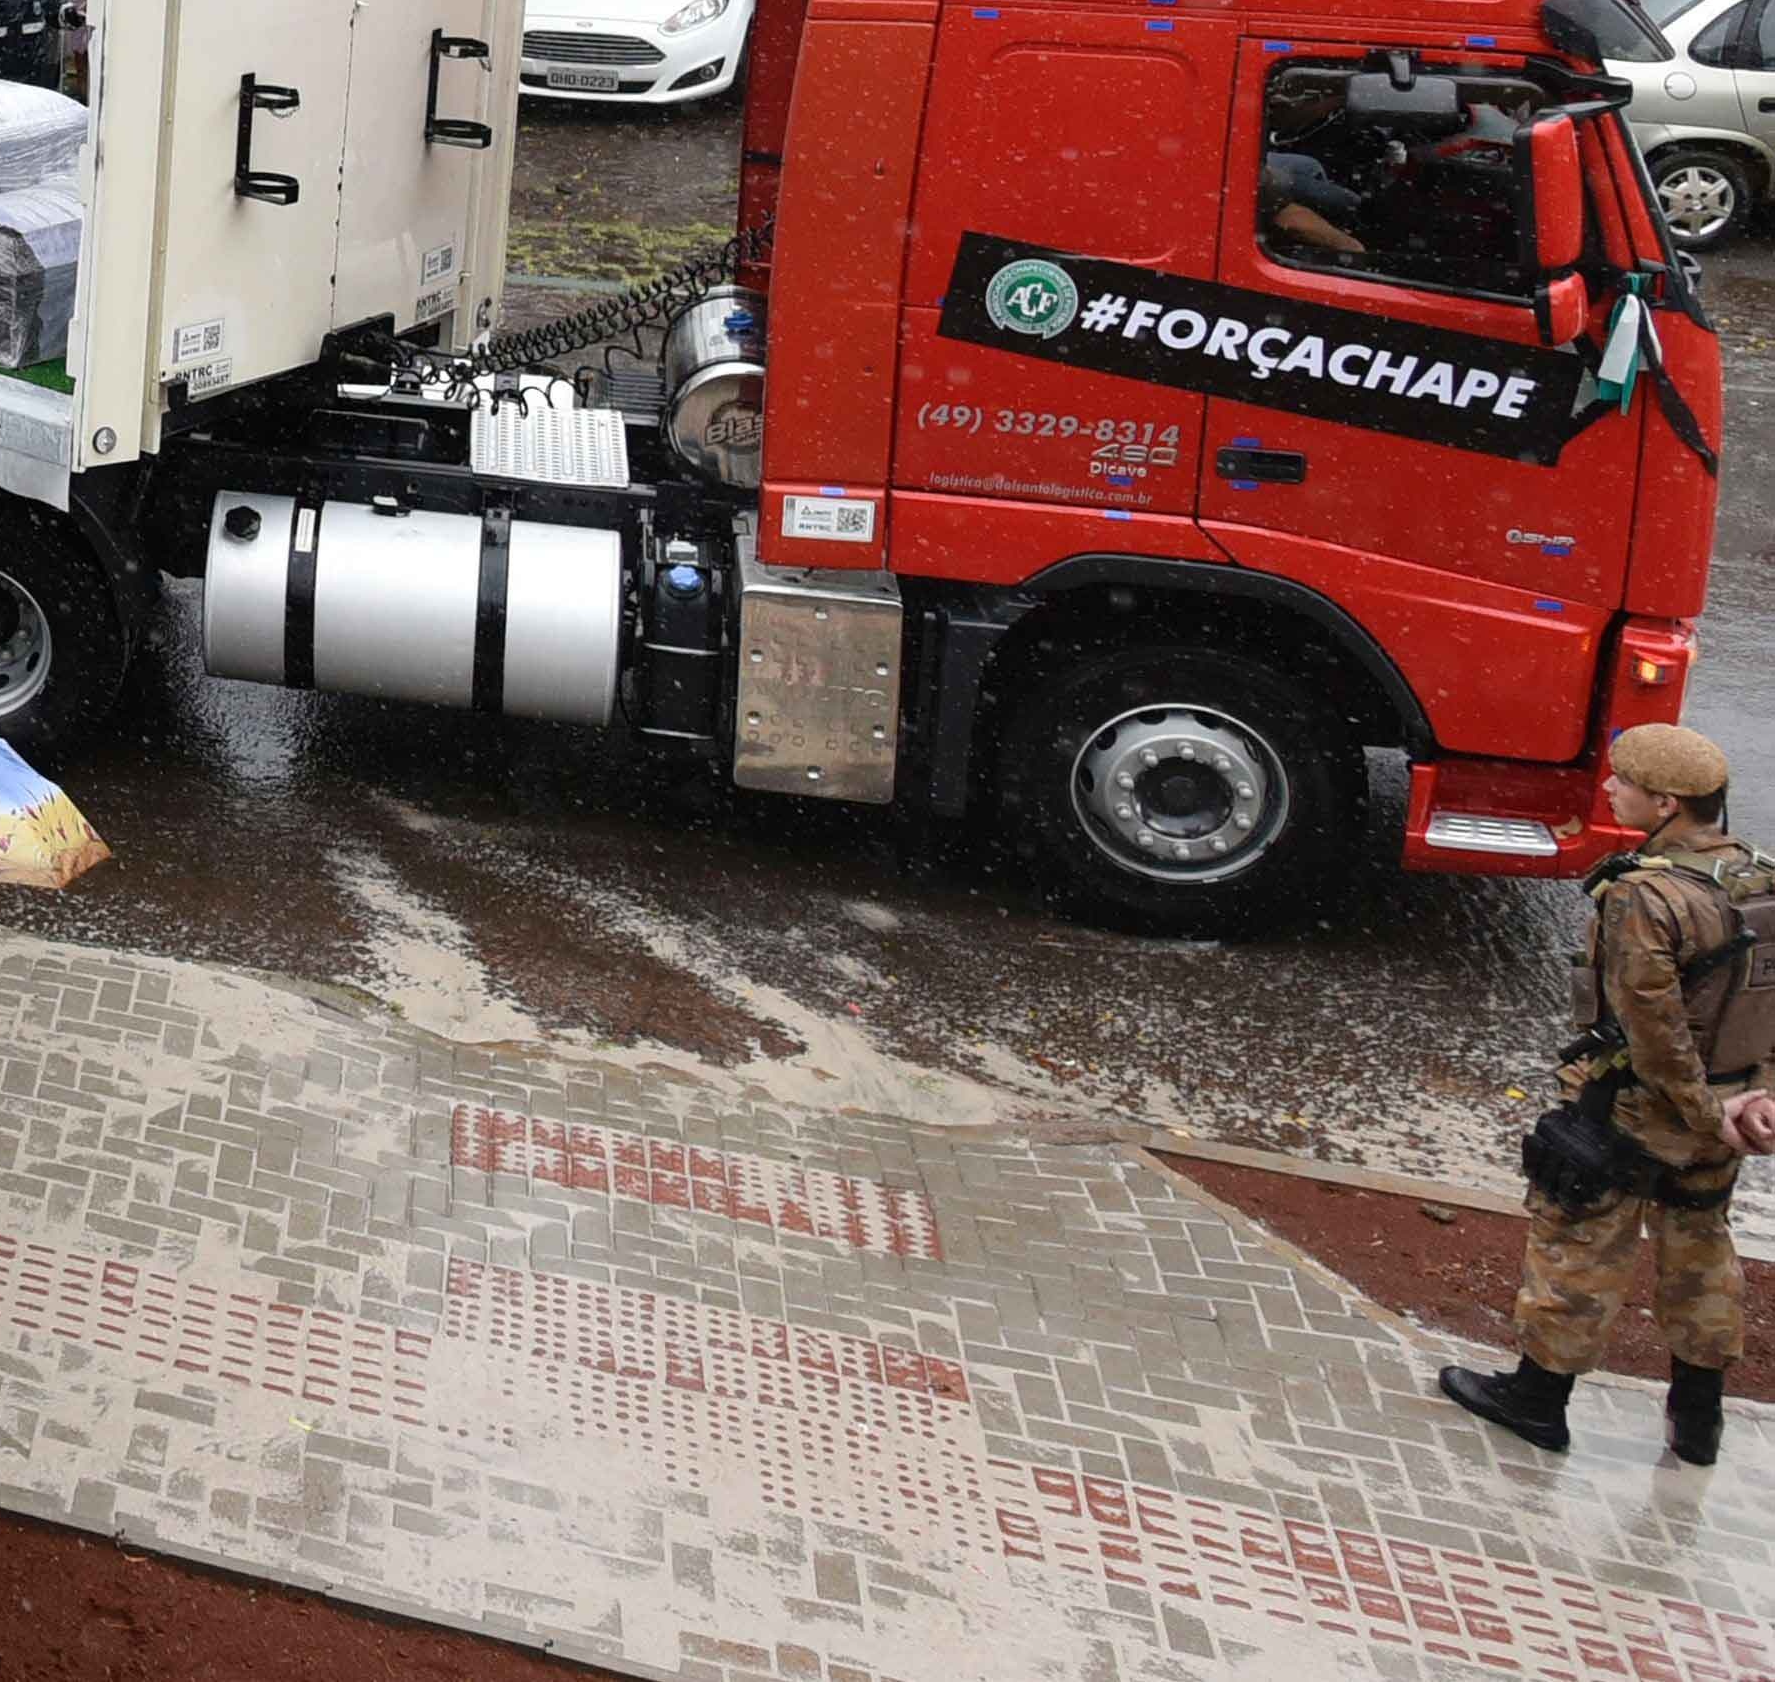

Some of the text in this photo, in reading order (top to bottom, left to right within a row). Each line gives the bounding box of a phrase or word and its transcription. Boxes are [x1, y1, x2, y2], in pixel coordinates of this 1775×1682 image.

[1080, 292, 1537, 419] #FORÇACHAPE
[917, 401, 1180, 447] (49) 3329-8314
